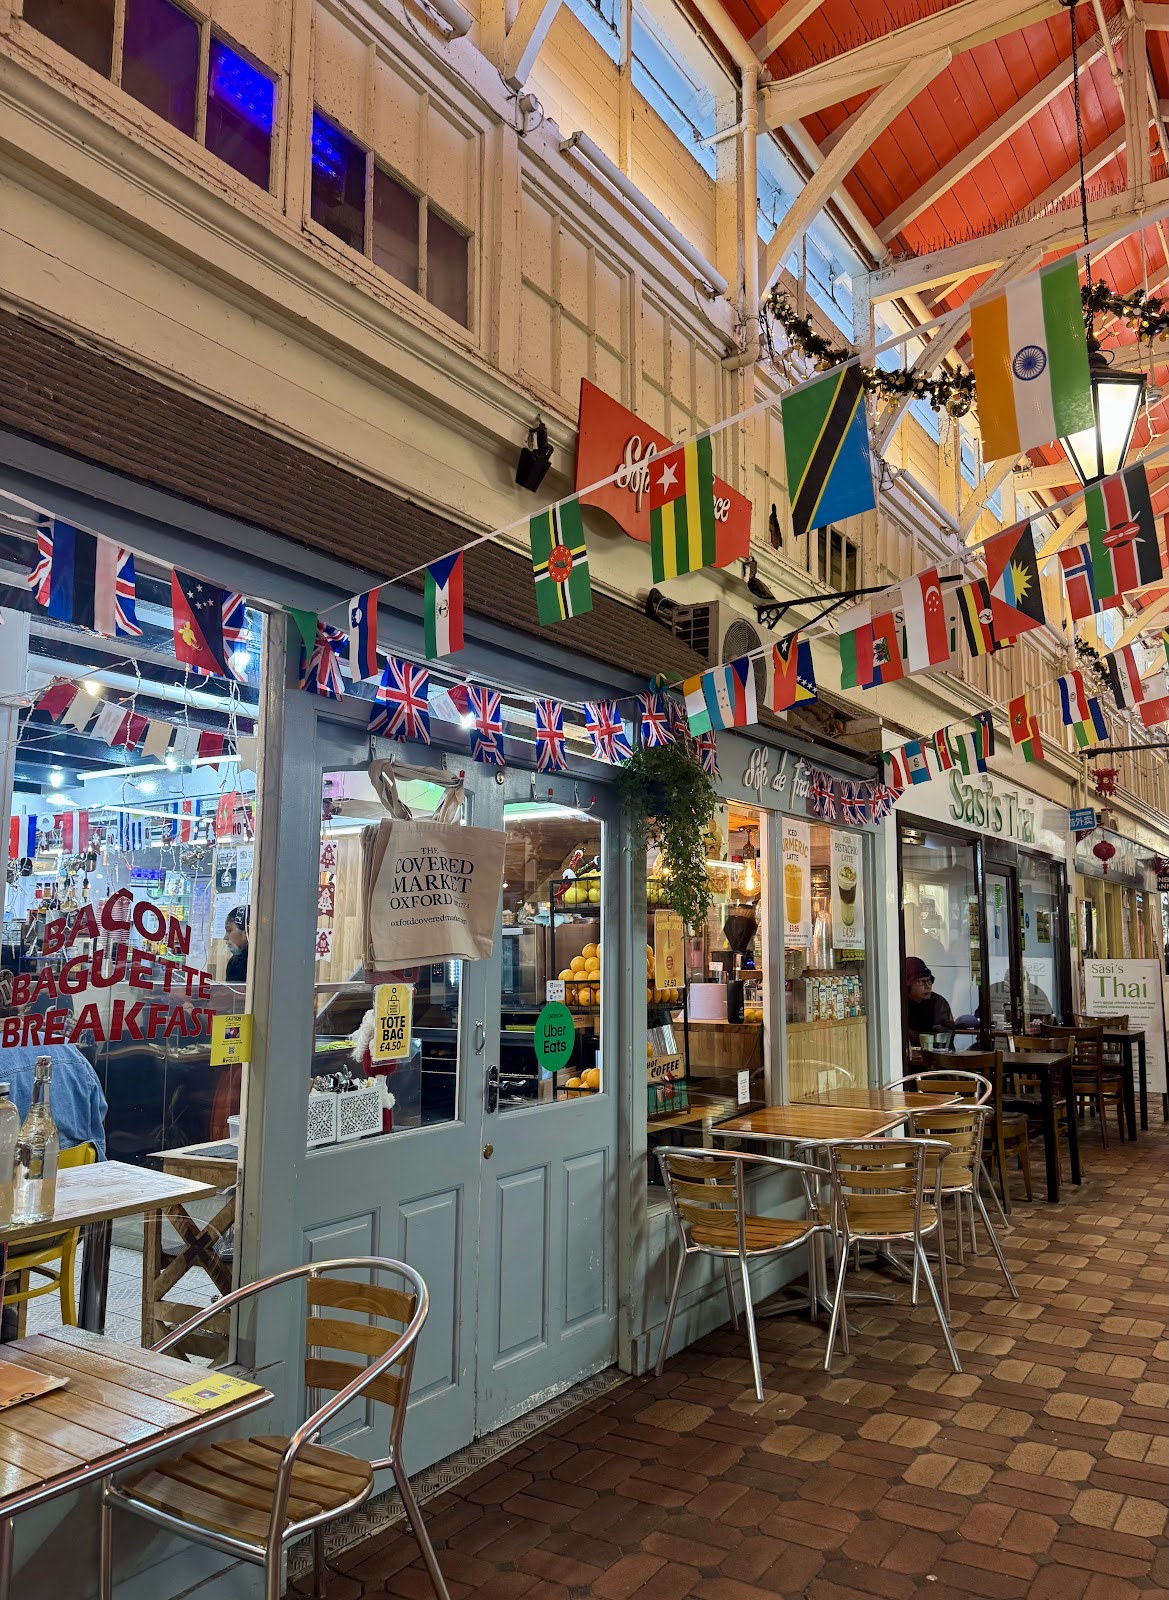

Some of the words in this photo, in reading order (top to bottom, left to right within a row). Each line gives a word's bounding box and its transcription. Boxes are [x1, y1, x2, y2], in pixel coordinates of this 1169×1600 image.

[773, 750, 787, 792] de
[949, 768, 1002, 833] Sasi's
[1001, 791, 1035, 844] Thai
[787, 829, 798, 837] ICED
[420, 847, 440, 855] THE
[782, 838, 809, 858] URMERIC
[786, 852, 799, 862] LATTE
[841, 855, 854, 863] LATTE
[395, 856, 474, 875] COVERED
[391, 873, 473, 893] MARKET
[390, 893, 453, 910] OXFORD
[42, 887, 192, 956] BACON
[11, 944, 213, 1007] BAGUETTE
[664, 979, 677, 988] £4.50
[1092, 976, 1147, 998] Thai
[2, 999, 217, 1049] BREAKFAST
[380, 1016, 406, 1029] TOTE
[382, 1028, 404, 1041] BAG
[543, 1024, 567, 1038] Uber
[380, 1041, 402, 1052] £4.50
[543, 1039, 567, 1054] Eats
[647, 1059, 658, 1069] HOT
[651, 1059, 680, 1078] COFFEE
